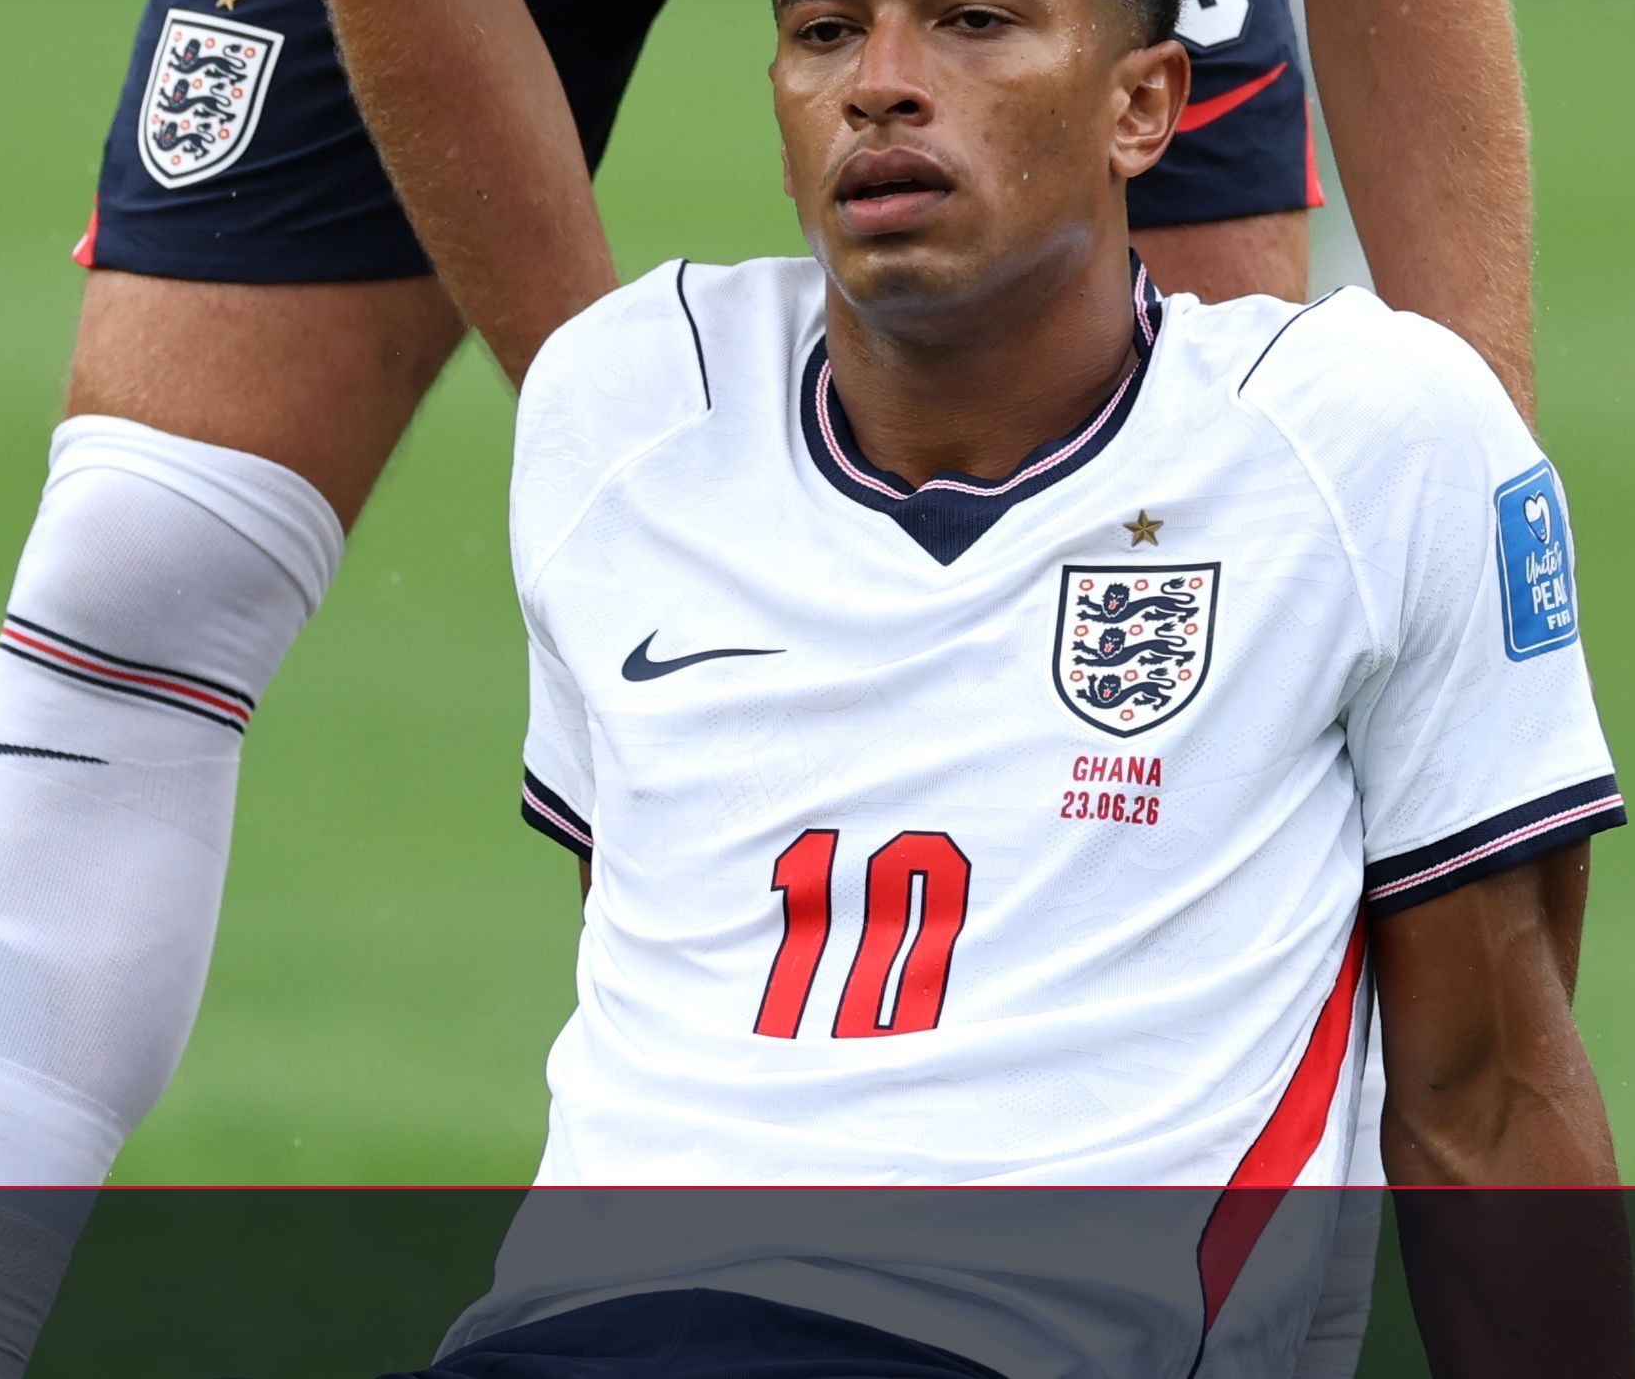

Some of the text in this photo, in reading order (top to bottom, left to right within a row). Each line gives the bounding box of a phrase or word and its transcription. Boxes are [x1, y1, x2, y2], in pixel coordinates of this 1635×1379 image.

[1072, 755, 1162, 787] GHANA
[1060, 790, 1161, 826] 23.06.26
[752, 828, 973, 1040] 10
